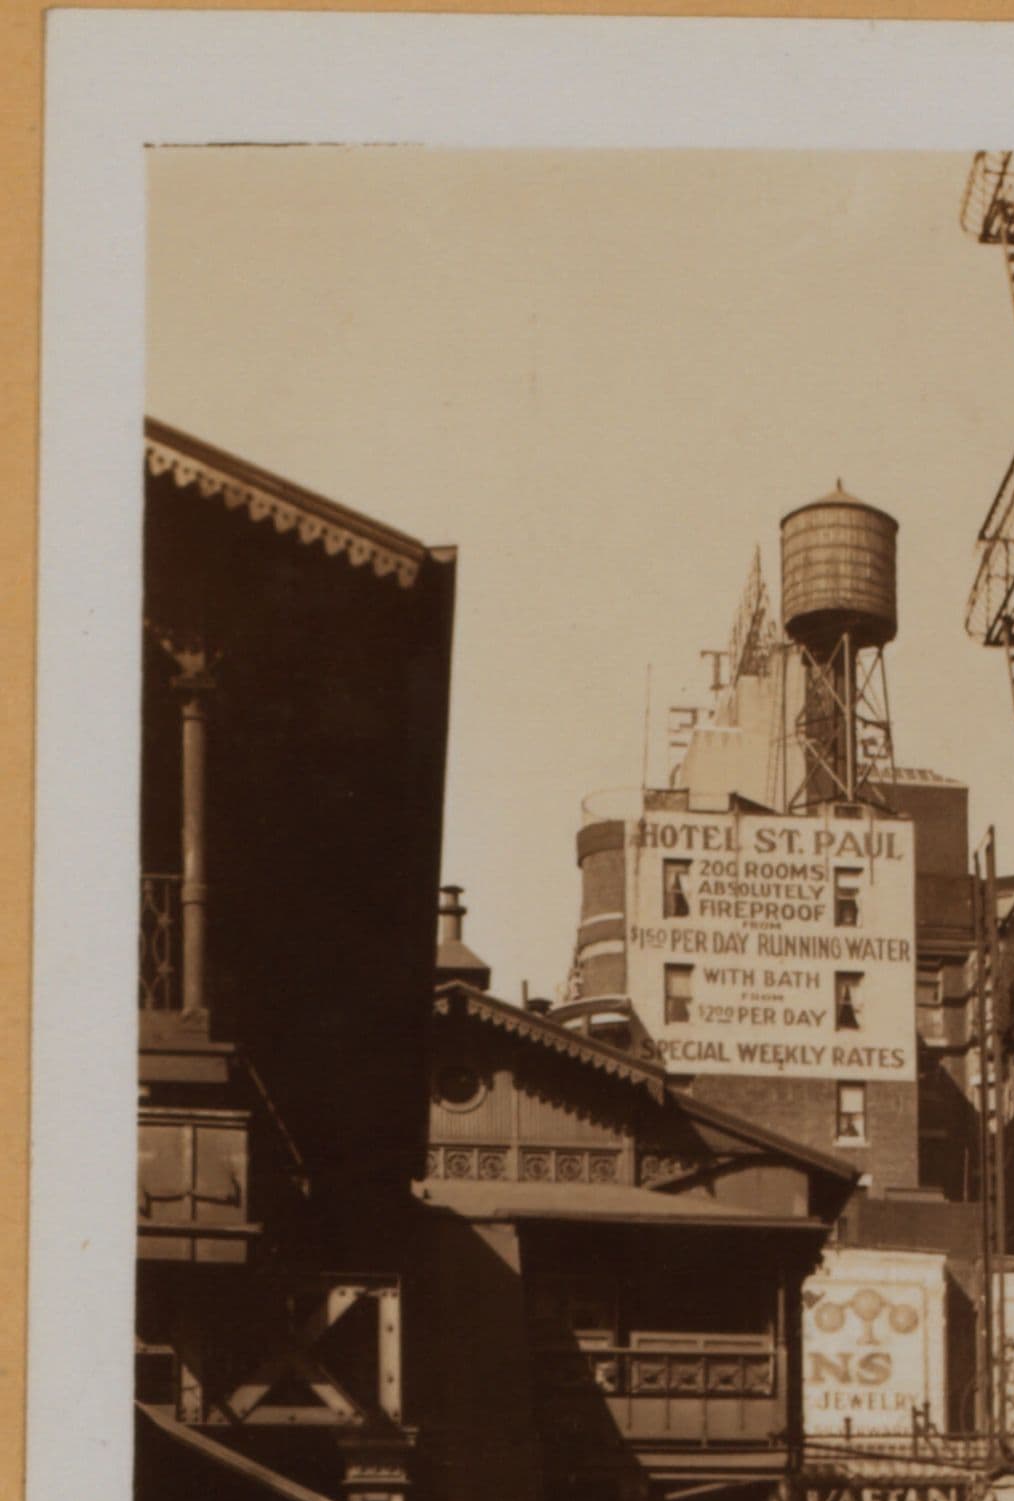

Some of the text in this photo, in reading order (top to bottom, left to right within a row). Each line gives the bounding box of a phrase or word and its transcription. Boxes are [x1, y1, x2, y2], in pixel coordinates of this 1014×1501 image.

[638, 823, 903, 860] HOTEL ST. PAUL
[745, 862, 825, 881] ROOMS
[698, 881, 825, 900] ABSOLUTELY
[700, 899, 826, 922] FIREPROOF
[670, 928, 709, 953] PER
[712, 931, 750, 956] DAY
[757, 933, 841, 960] RUNNING
[844, 937, 911, 963] WATER
[703, 967, 820, 989] WITH BATH
[738, 1006, 777, 1025] PER
[783, 1008, 828, 1027] DAY
[641, 1037, 907, 1070] SPECIAL WEEKLY RATES
[808, 1352, 892, 1385] NS
